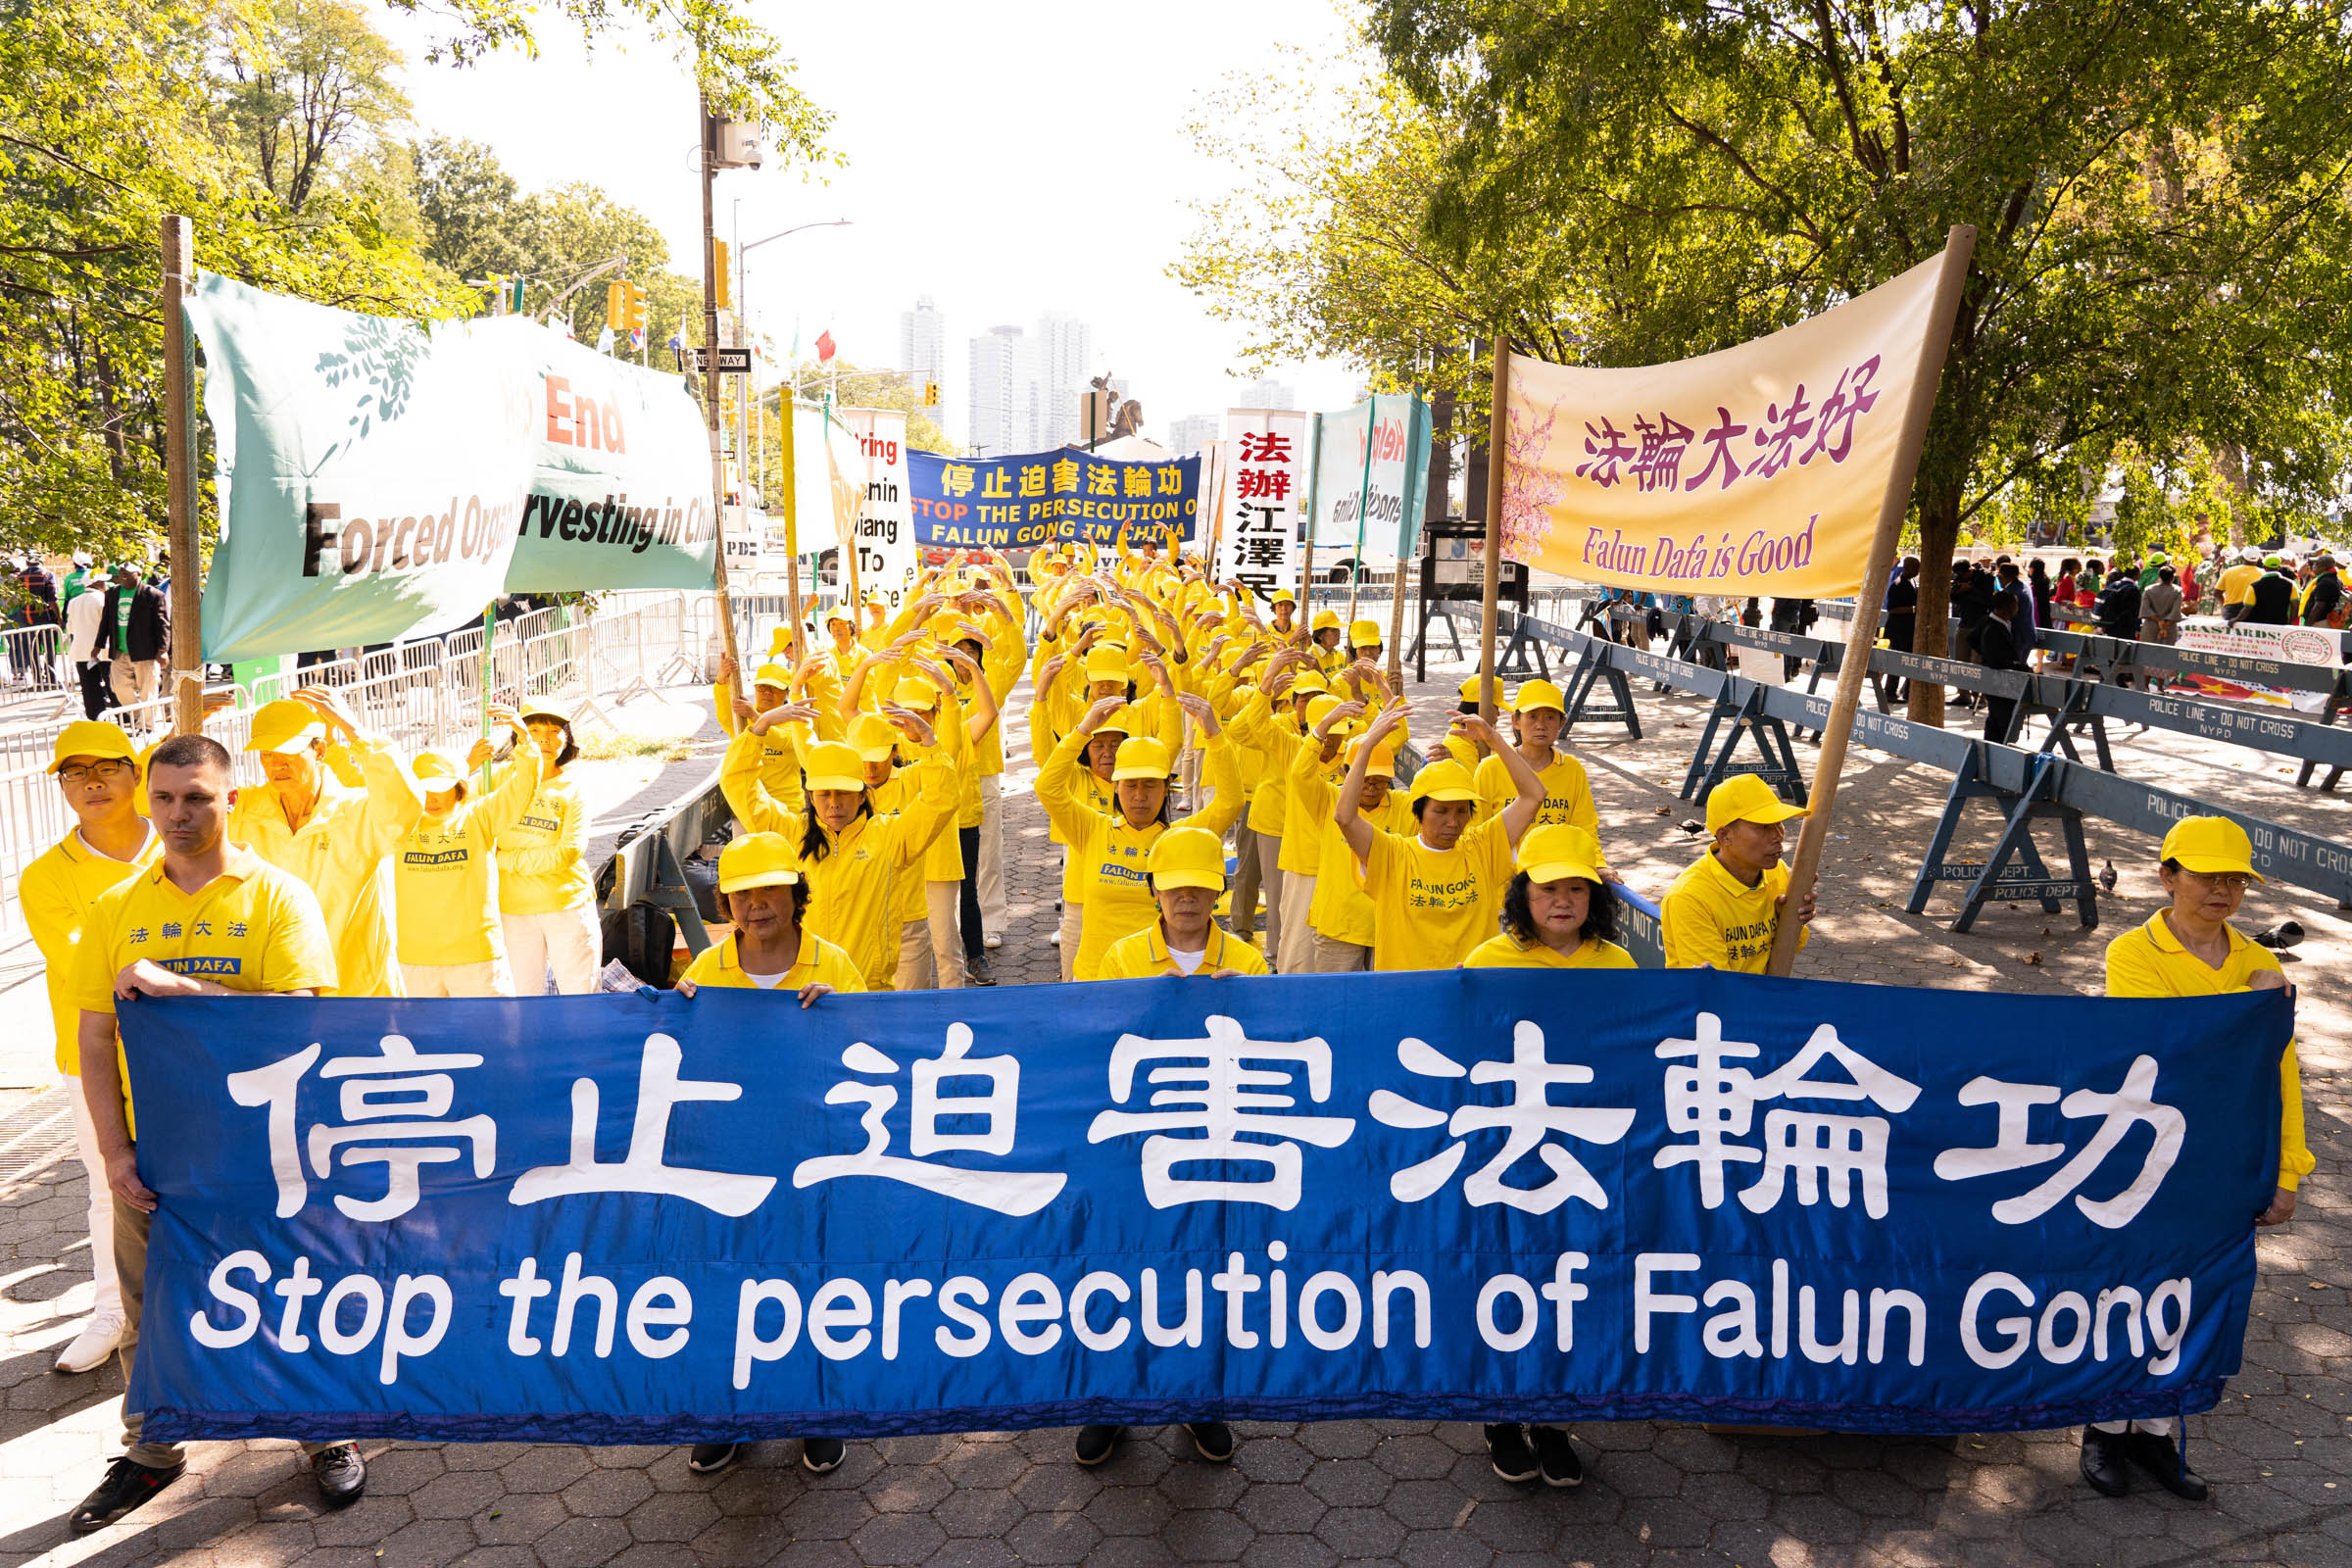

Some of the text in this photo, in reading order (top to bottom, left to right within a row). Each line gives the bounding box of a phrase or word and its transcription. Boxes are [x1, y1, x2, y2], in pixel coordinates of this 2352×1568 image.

[719, 355, 742, 366] WAY
[546, 374, 626, 455] End
[1575, 354, 1882, 492] 法輪大法好
[855, 432, 897, 466] ring
[863, 477, 898, 502] min
[941, 458, 1182, 499] 停止迫害法輪功
[910, 497, 968, 521] STOP
[976, 505, 1021, 523] THE
[1029, 498, 1179, 521] PERSECUTION
[303, 496, 458, 577] Forced
[518, 493, 660, 554] rvesting
[658, 497, 683, 545] in
[931, 524, 1009, 545] FALUN
[1016, 520, 1076, 543] GONG
[1083, 523, 1112, 540] IN
[1582, 513, 1820, 579] Falun Dafa is Good
[858, 547, 885, 572] To
[1901, 655, 1919, 667] POLICE
[1922, 659, 1934, 670] LINE
[2179, 650, 2200, 662] POLICE
[2204, 655, 2220, 665] LINE
[2229, 658, 2237, 668] DO
[2239, 659, 2254, 670] NOT
[2256, 662, 2279, 674] CROSS
[1805, 700, 1909, 740] POLICE DO NOT CROSS
[2148, 698, 2179, 716] POLICE
[2185, 706, 2206, 722] LINE
[2220, 712, 2233, 727] DO
[2236, 715, 2258, 732] NOT
[2260, 720, 2294, 739] CROSS
[2200, 723, 2231, 739] NYPD
[1544, 798, 1569, 810] DAFA
[2147, 793, 2191, 820] POLICE
[437, 851, 466, 863] DAFA
[2255, 826, 2352, 875] DO NOT CRO
[1104, 865, 1140, 880] FALUN
[1994, 885, 2080, 900] POLICE DEPT
[129, 919, 248, 944] 法輪大法
[1633, 907, 1653, 942] NOT
[226, 1011, 2186, 1229] 停止迫害法輪功
[190, 1240, 2192, 1390] Stop the persecution of Falun Gong
